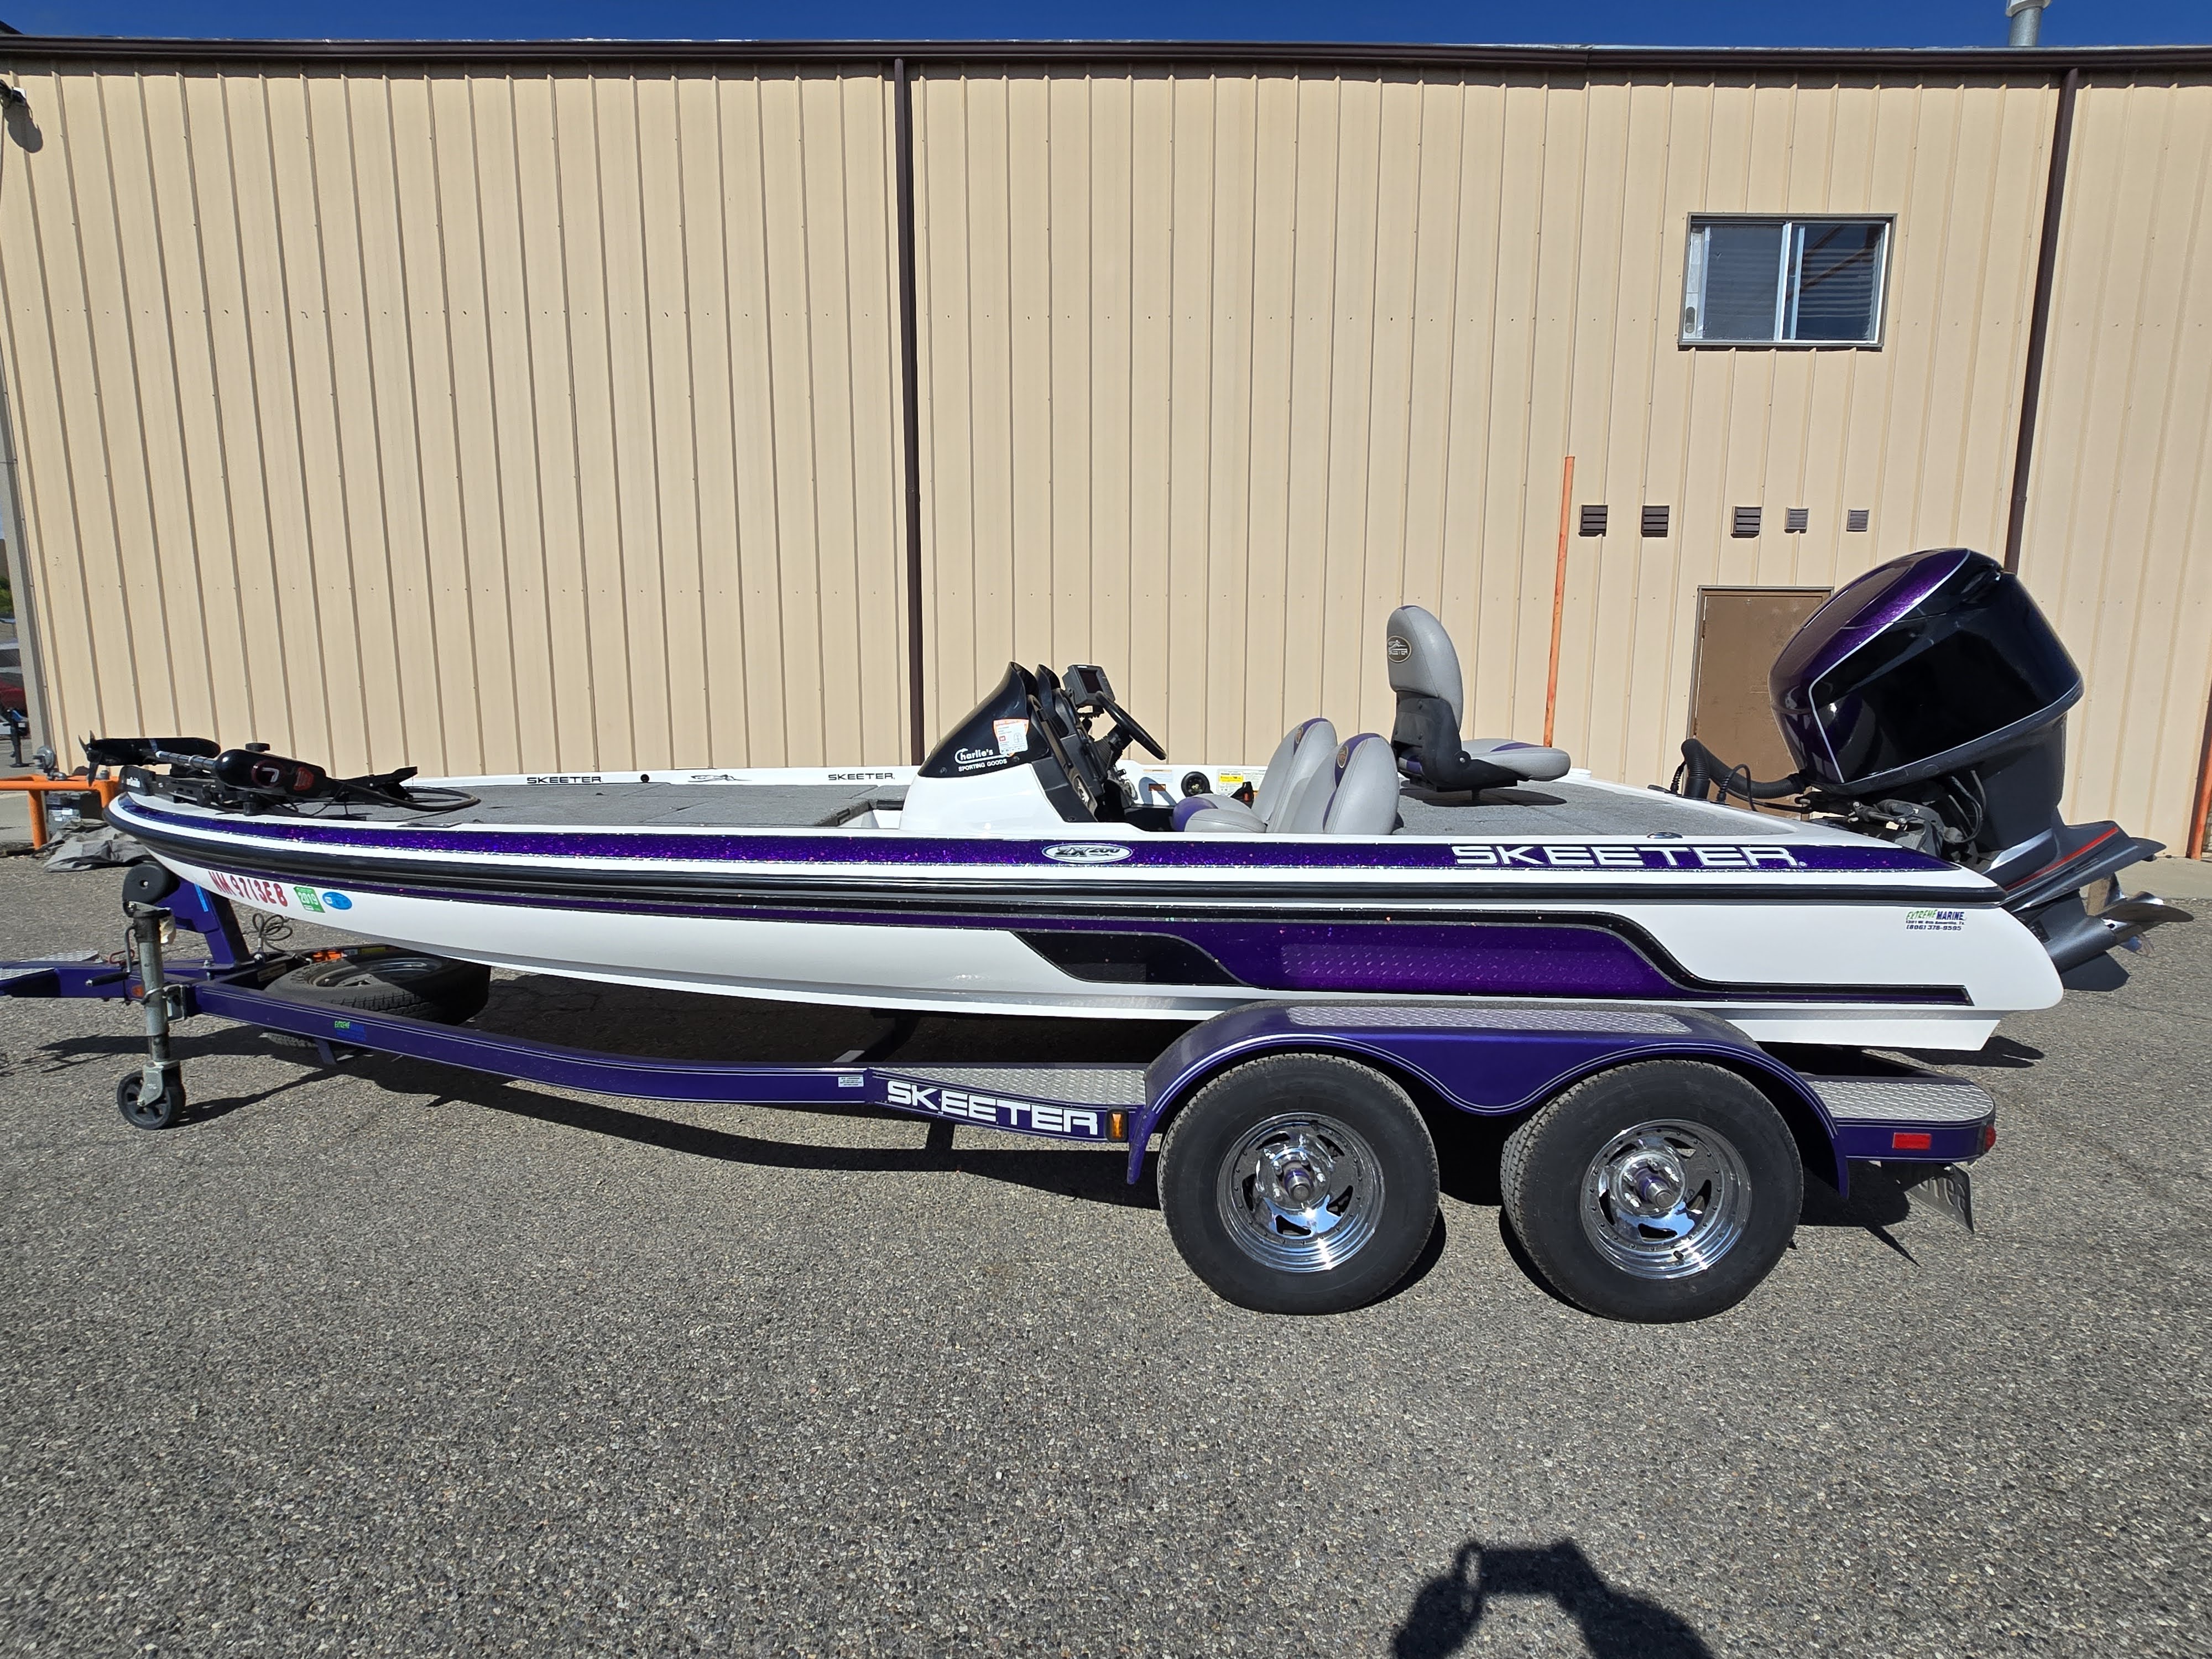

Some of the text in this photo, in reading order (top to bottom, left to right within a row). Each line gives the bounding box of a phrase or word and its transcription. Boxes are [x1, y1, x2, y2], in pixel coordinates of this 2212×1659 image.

[954, 748, 994, 764] Charlie's
[958, 758, 1008, 772] SPORTING GOODS
[526, 776, 602, 784] SKEETER
[828, 773, 894, 781] SKEETER
[1451, 846, 1801, 867] SKEETER
[298, 891, 319, 906] 2019
[1905, 909, 1965, 921] EXTREME MARINE
[887, 1080, 1098, 1135] SKEETER
